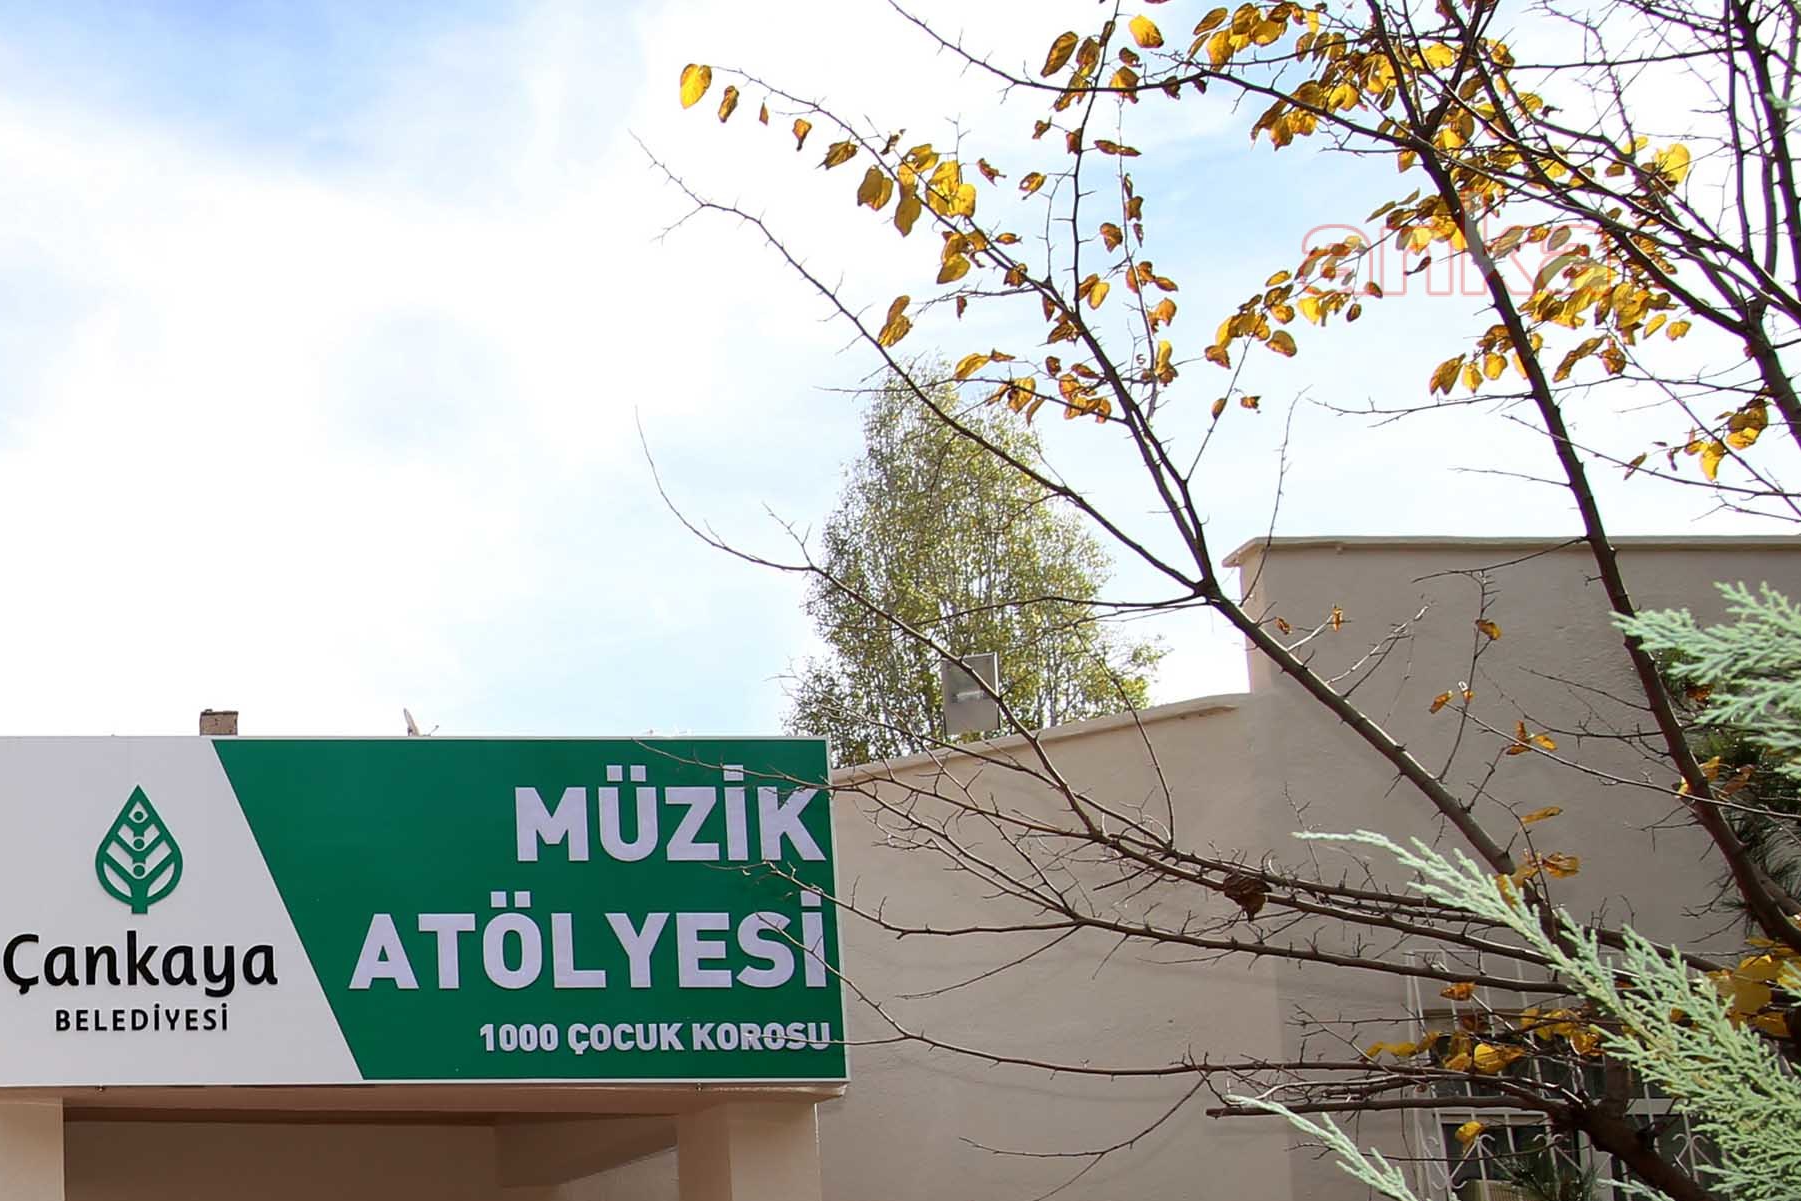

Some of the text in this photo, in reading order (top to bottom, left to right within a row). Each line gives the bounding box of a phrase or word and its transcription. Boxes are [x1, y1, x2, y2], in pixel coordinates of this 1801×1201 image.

[514, 764, 827, 862] MÜZİK
[2, 929, 279, 998] Çankaya
[348, 890, 827, 990] ATÖLYESİ
[55, 1003, 229, 1032] BELEDİYESİ
[479, 1021, 832, 1056] 1000 ÇOCUK KOROSU
